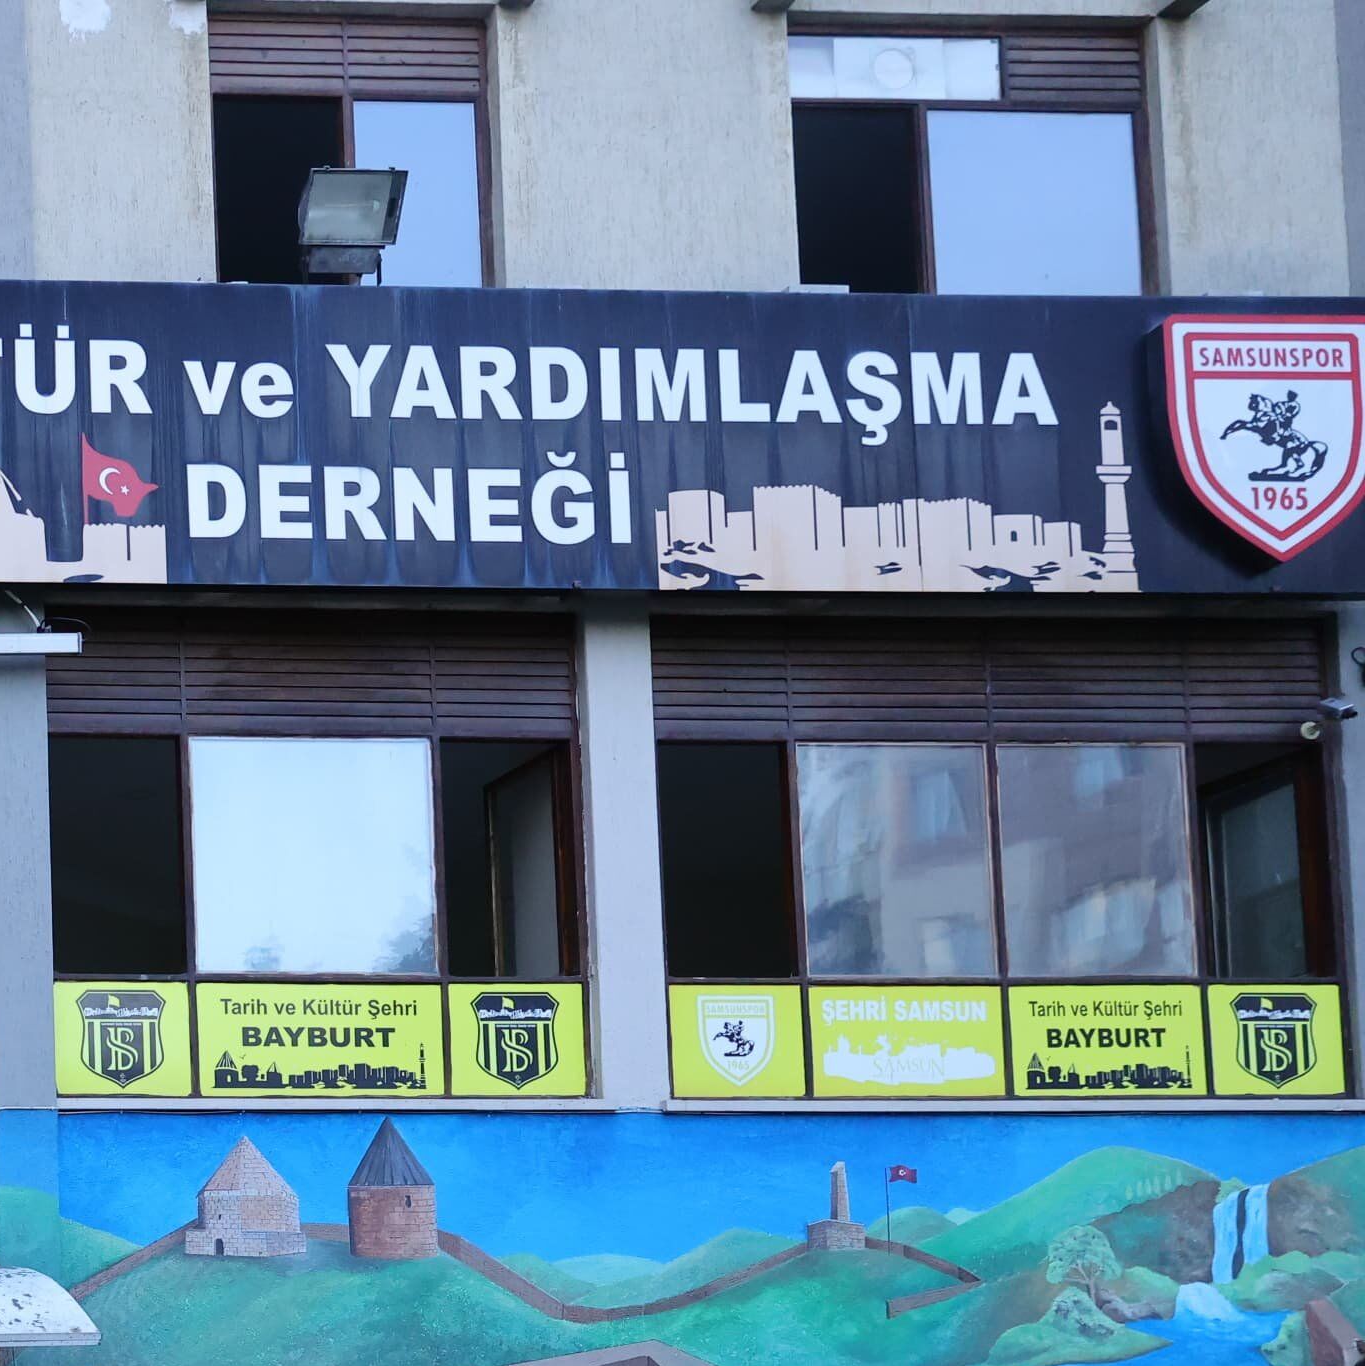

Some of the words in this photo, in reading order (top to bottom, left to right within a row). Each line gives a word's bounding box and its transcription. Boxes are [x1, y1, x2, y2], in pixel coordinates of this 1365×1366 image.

[1199, 347, 1344, 368] SAMSUNSPOR
[183, 359, 294, 418] ve
[325, 344, 1059, 446] YARDIMLAŞMA
[185, 452, 633, 544] DERNEĞİ
[1251, 487, 1308, 510] 1965
[220, 998, 267, 1015] Tarih
[274, 1003, 296, 1015] ve
[302, 999, 362, 1015] Kültür
[369, 1000, 417, 1019] Şehri
[822, 995, 888, 1026] ŞEHRİ
[894, 1000, 988, 1021] SAMSUN
[1029, 1000, 1066, 1017] Tarih
[1071, 1004, 1088, 1017] ve
[1093, 1000, 1139, 1017] Kültür
[1143, 1000, 1182, 1020] Şehri
[241, 1026, 396, 1047] BAYBURT
[1046, 1028, 1166, 1048] BAYBURT
